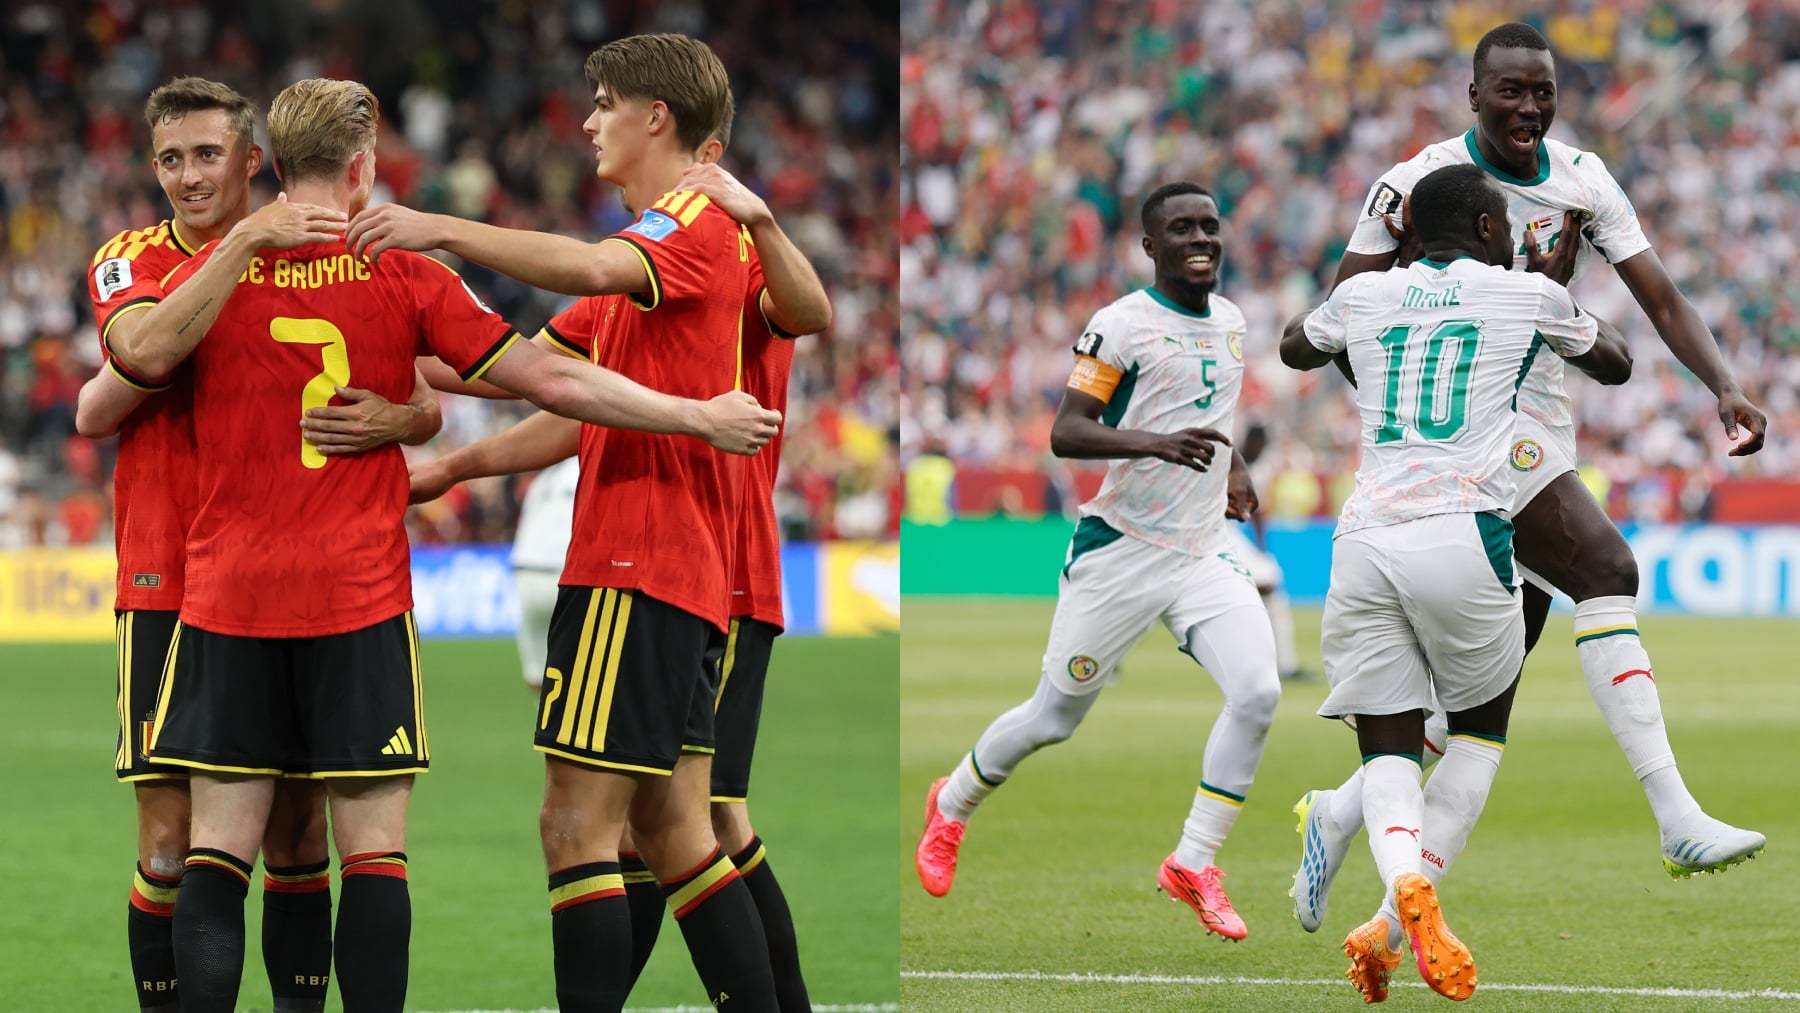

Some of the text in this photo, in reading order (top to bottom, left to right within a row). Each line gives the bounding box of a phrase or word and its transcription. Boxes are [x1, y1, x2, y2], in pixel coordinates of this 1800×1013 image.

[274, 254, 372, 290] BRUYNE
[269, 316, 351, 470] 7
[1194, 359, 1217, 410] 5
[1374, 319, 1485, 444] 10
[540, 666, 564, 731] 7
